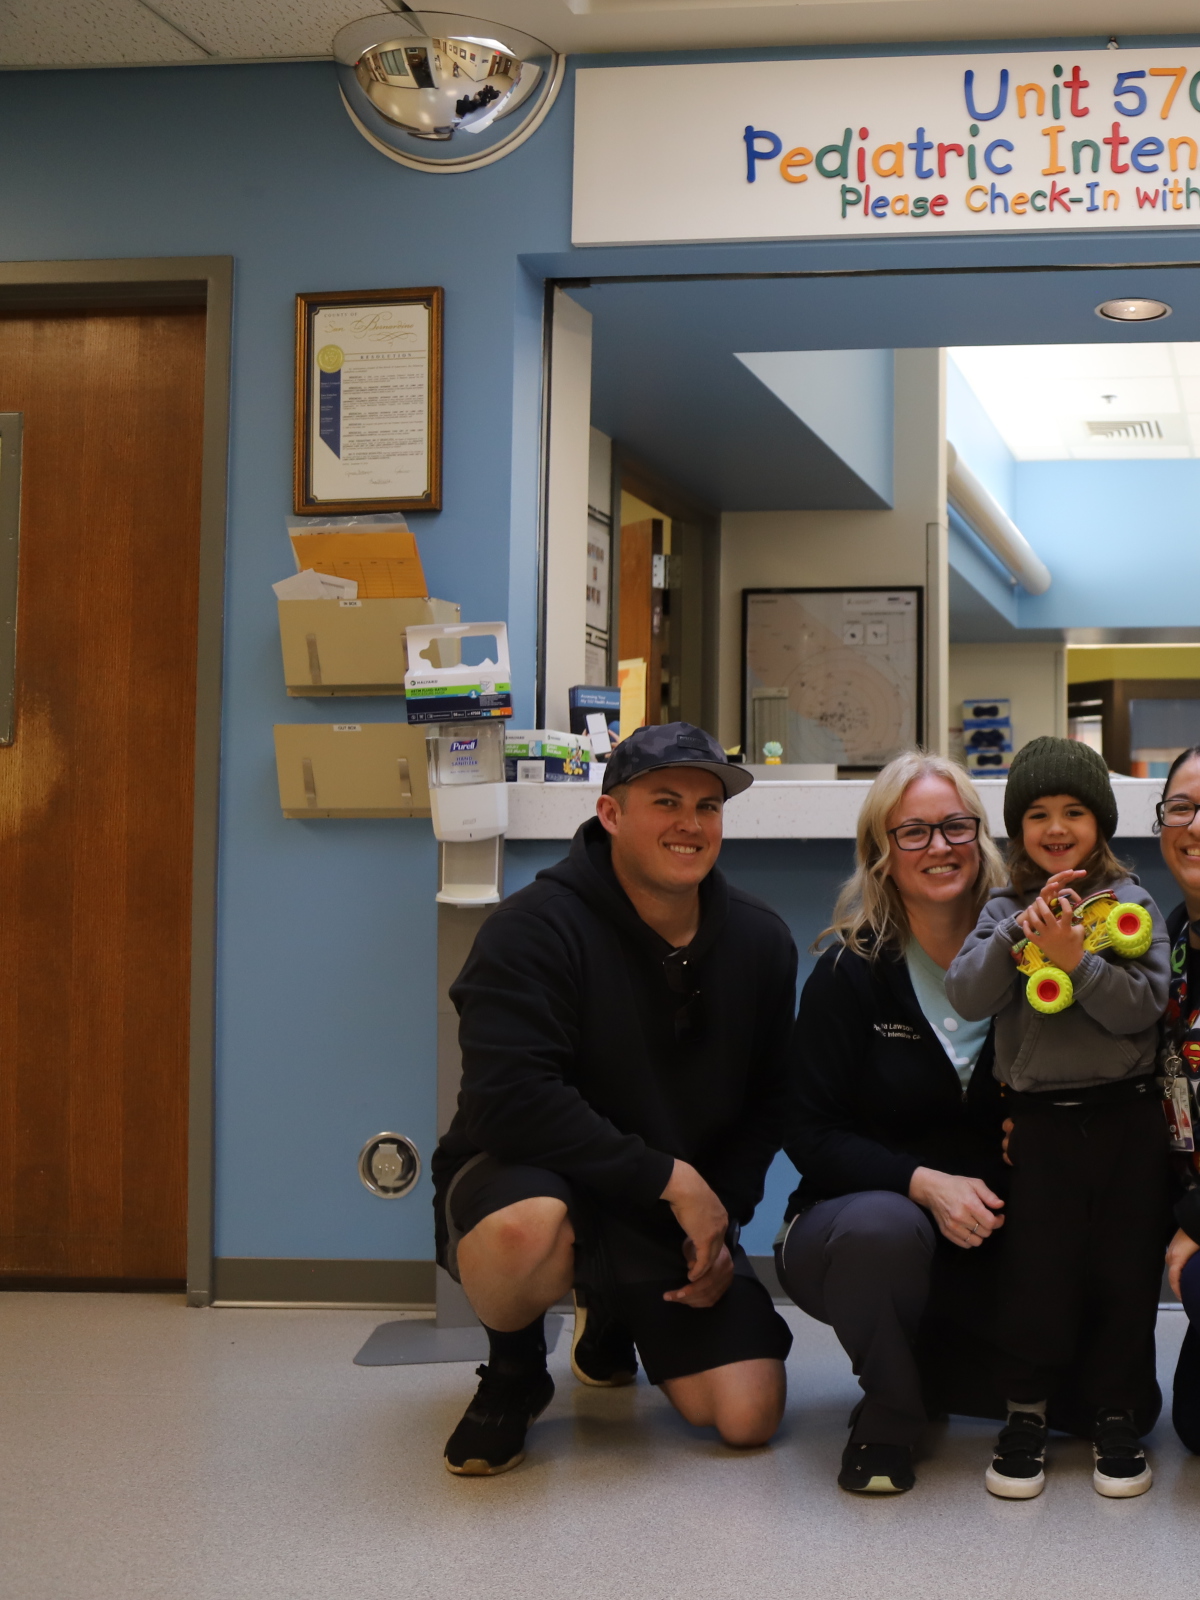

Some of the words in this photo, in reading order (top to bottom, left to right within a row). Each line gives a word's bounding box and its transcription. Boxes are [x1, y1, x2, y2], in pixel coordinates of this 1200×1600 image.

[964, 64, 1090, 121] Unit
[743, 124, 1014, 183] Pediatric
[841, 183, 949, 218] Please
[965, 180, 1120, 214] Check-In
[324, 321, 345, 333] San
[349, 311, 415, 339] Bernardino
[471, 690, 477, 698] 1
